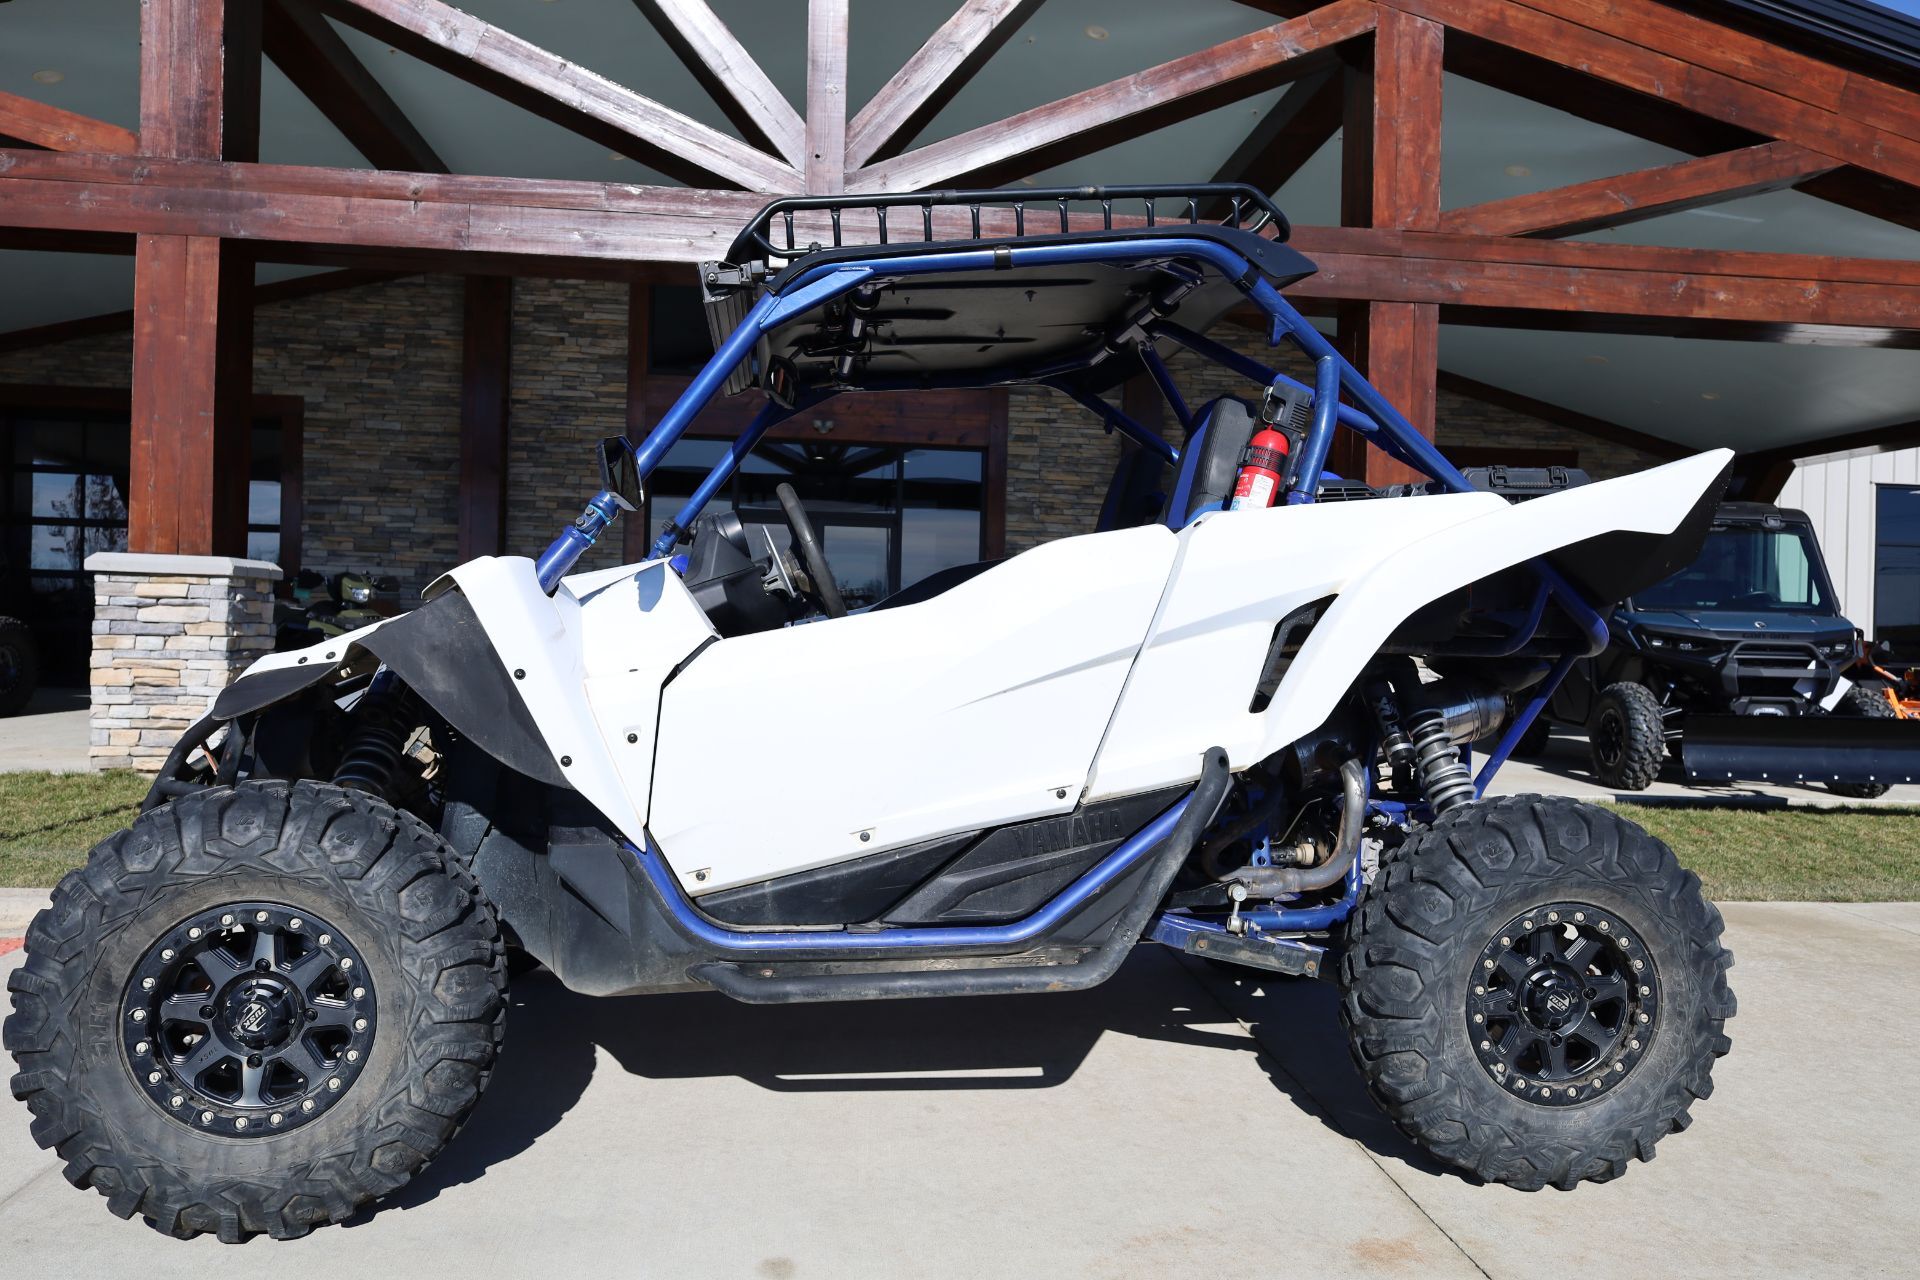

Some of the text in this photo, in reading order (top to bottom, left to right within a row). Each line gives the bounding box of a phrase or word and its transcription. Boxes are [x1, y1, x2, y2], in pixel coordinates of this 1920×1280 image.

[1010, 808, 1122, 858] YAMAHA
[1548, 994, 1568, 1011] TUSK
[242, 1006, 267, 1028] TUSK
